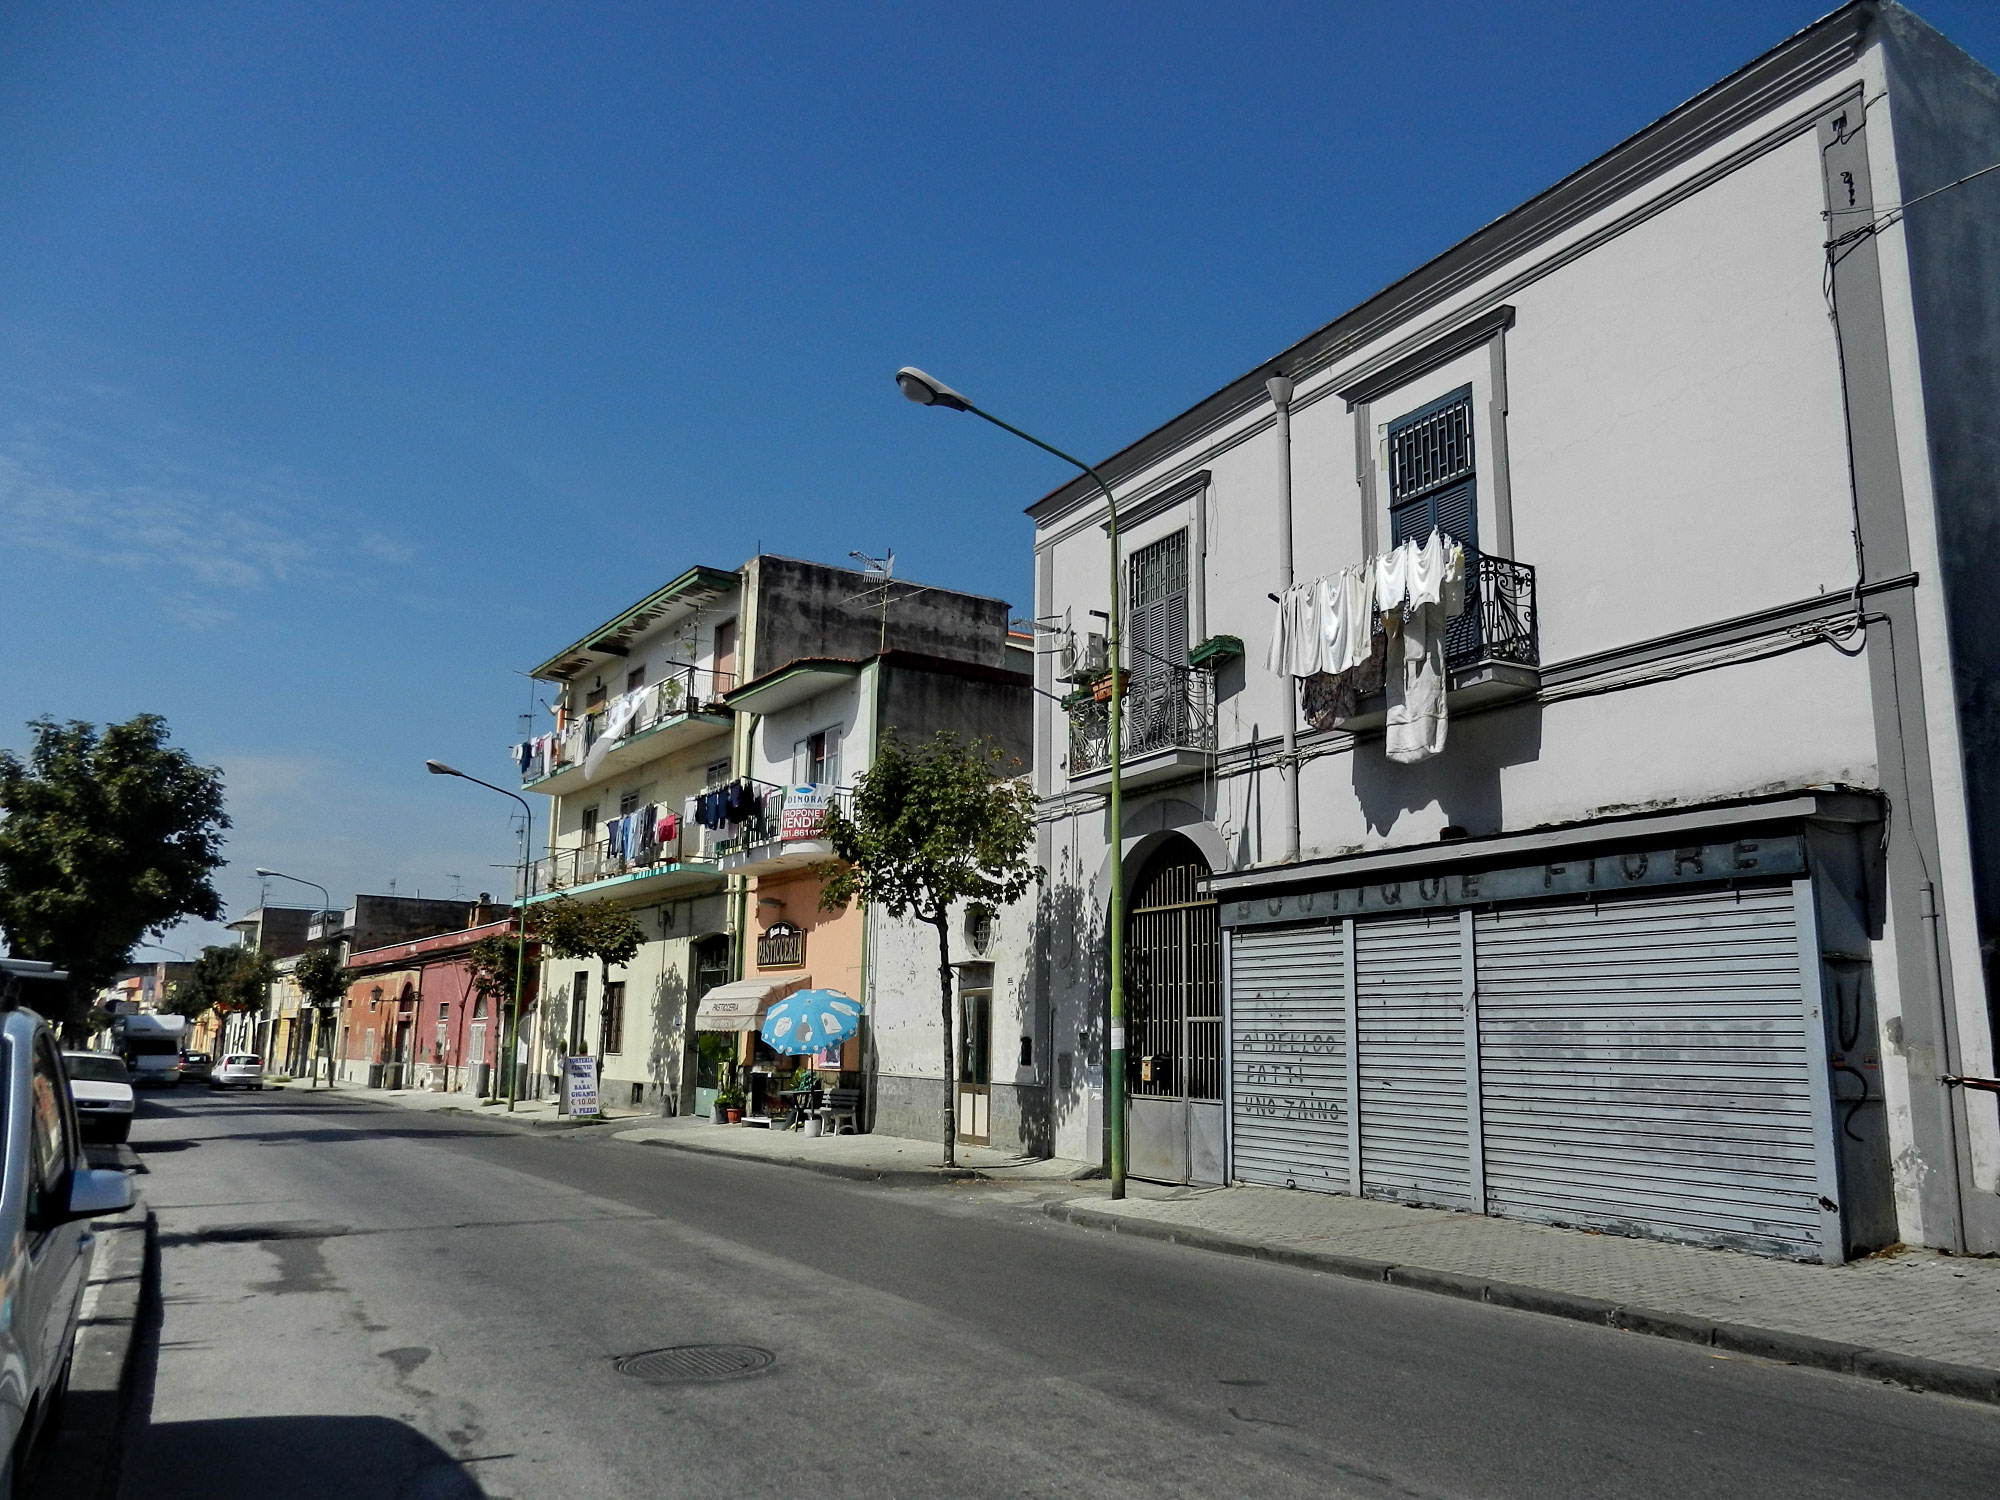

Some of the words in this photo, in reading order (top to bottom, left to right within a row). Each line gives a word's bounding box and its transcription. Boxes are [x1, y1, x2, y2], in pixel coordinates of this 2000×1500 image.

[1543, 840, 1761, 889] FIORE
[758, 937, 801, 964] PASTICCERIA
[712, 1003, 740, 1012] PASTICCERIA
[1245, 1096, 1277, 1116] UNO
